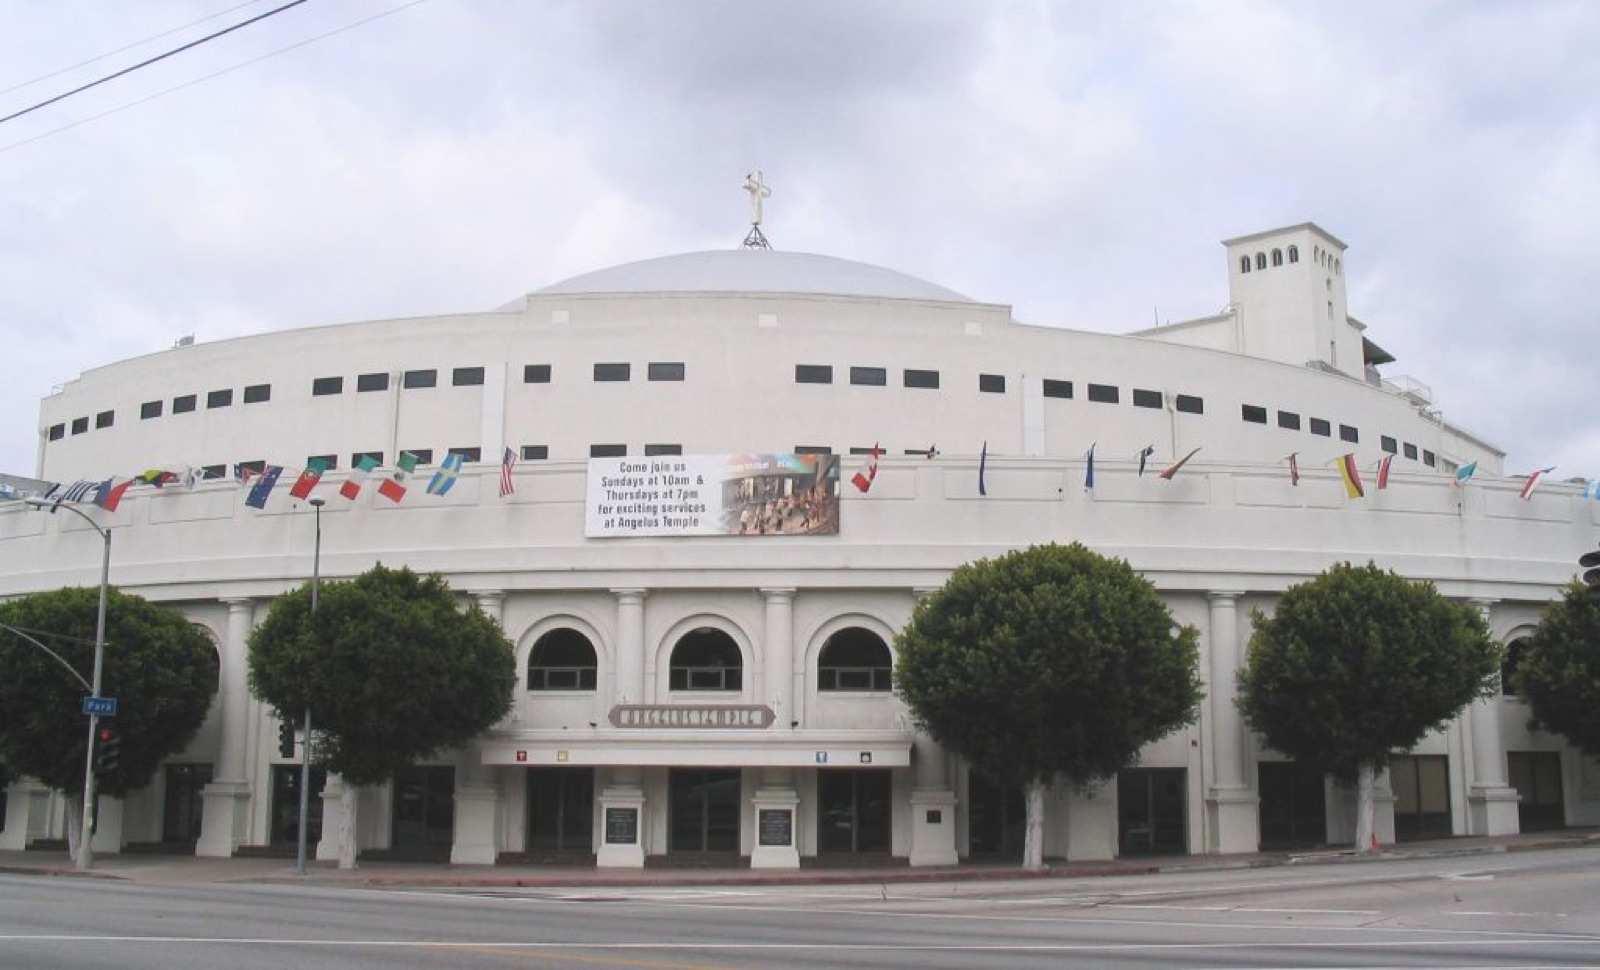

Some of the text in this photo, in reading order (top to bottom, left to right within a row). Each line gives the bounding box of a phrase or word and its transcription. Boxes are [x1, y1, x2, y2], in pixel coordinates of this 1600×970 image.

[620, 461, 686, 474] Come join us
[602, 474, 704, 487] Sundays at 10am &
[606, 489, 698, 501] Thursdays at 7pm
[598, 503, 706, 515] for exciting services
[605, 516, 699, 529] at Angelus Temple
